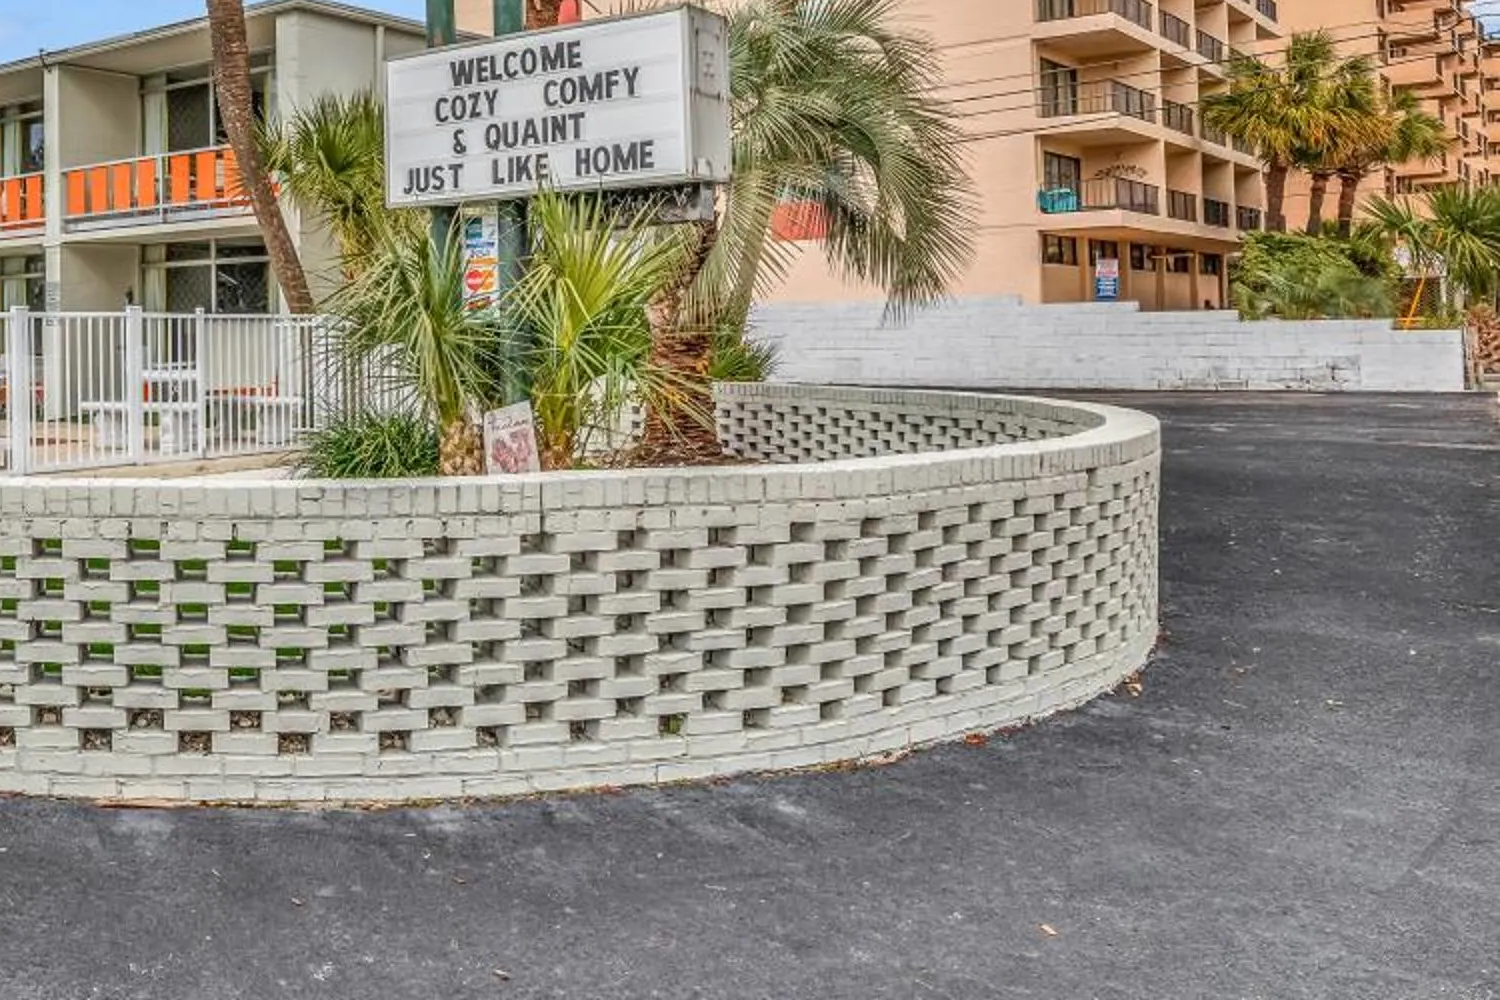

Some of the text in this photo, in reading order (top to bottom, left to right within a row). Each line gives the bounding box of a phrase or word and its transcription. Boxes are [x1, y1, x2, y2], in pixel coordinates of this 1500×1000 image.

[449, 40, 583, 87] WELCOME
[435, 66, 640, 123] COZY COMFY
[452, 112, 585, 154] & QUAINT
[403, 140, 655, 194] JUST LIKE HOME
